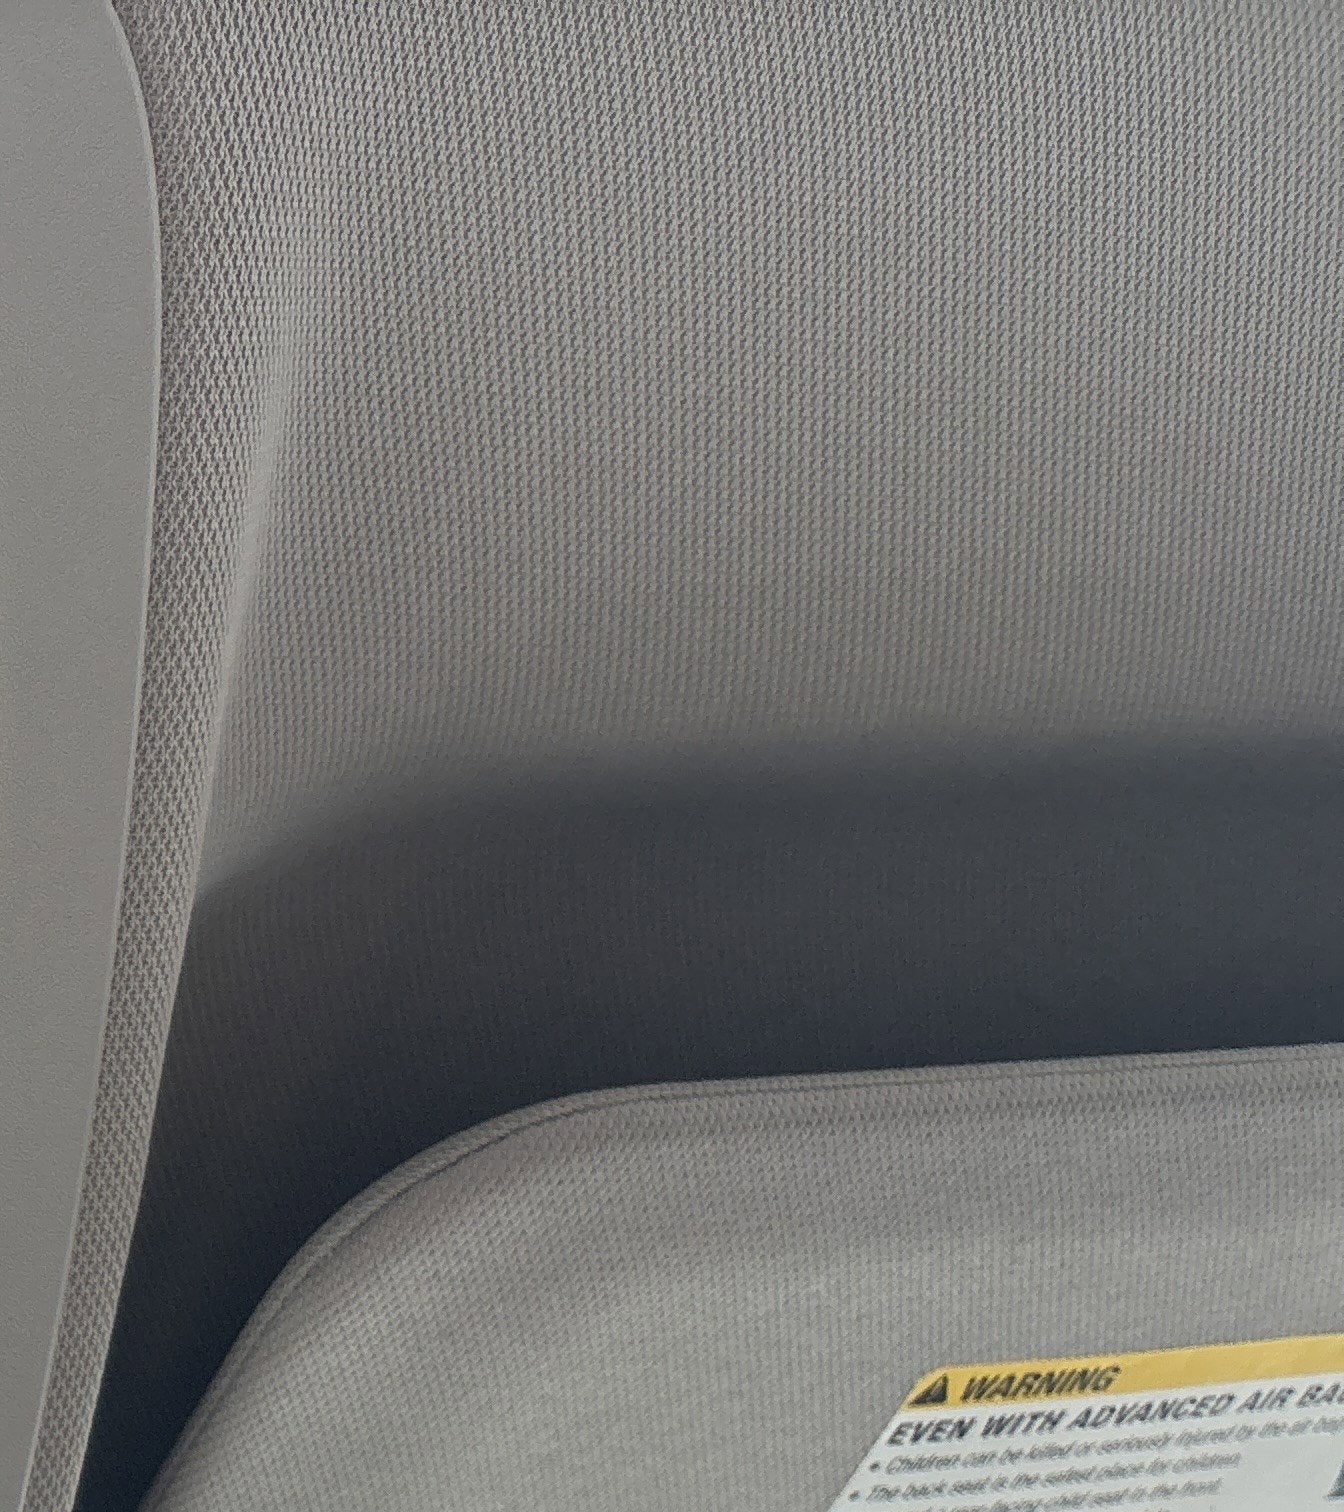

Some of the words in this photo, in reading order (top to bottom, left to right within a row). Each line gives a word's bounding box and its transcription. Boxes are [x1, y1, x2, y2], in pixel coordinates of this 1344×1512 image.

[959, 1365, 1121, 1401] WARNING
[887, 1417, 977, 1446] EVEN
[981, 1408, 1067, 1440] WITH
[1065, 1393, 1235, 1431] ADVANCED
[1236, 1387, 1296, 1414] AIR
